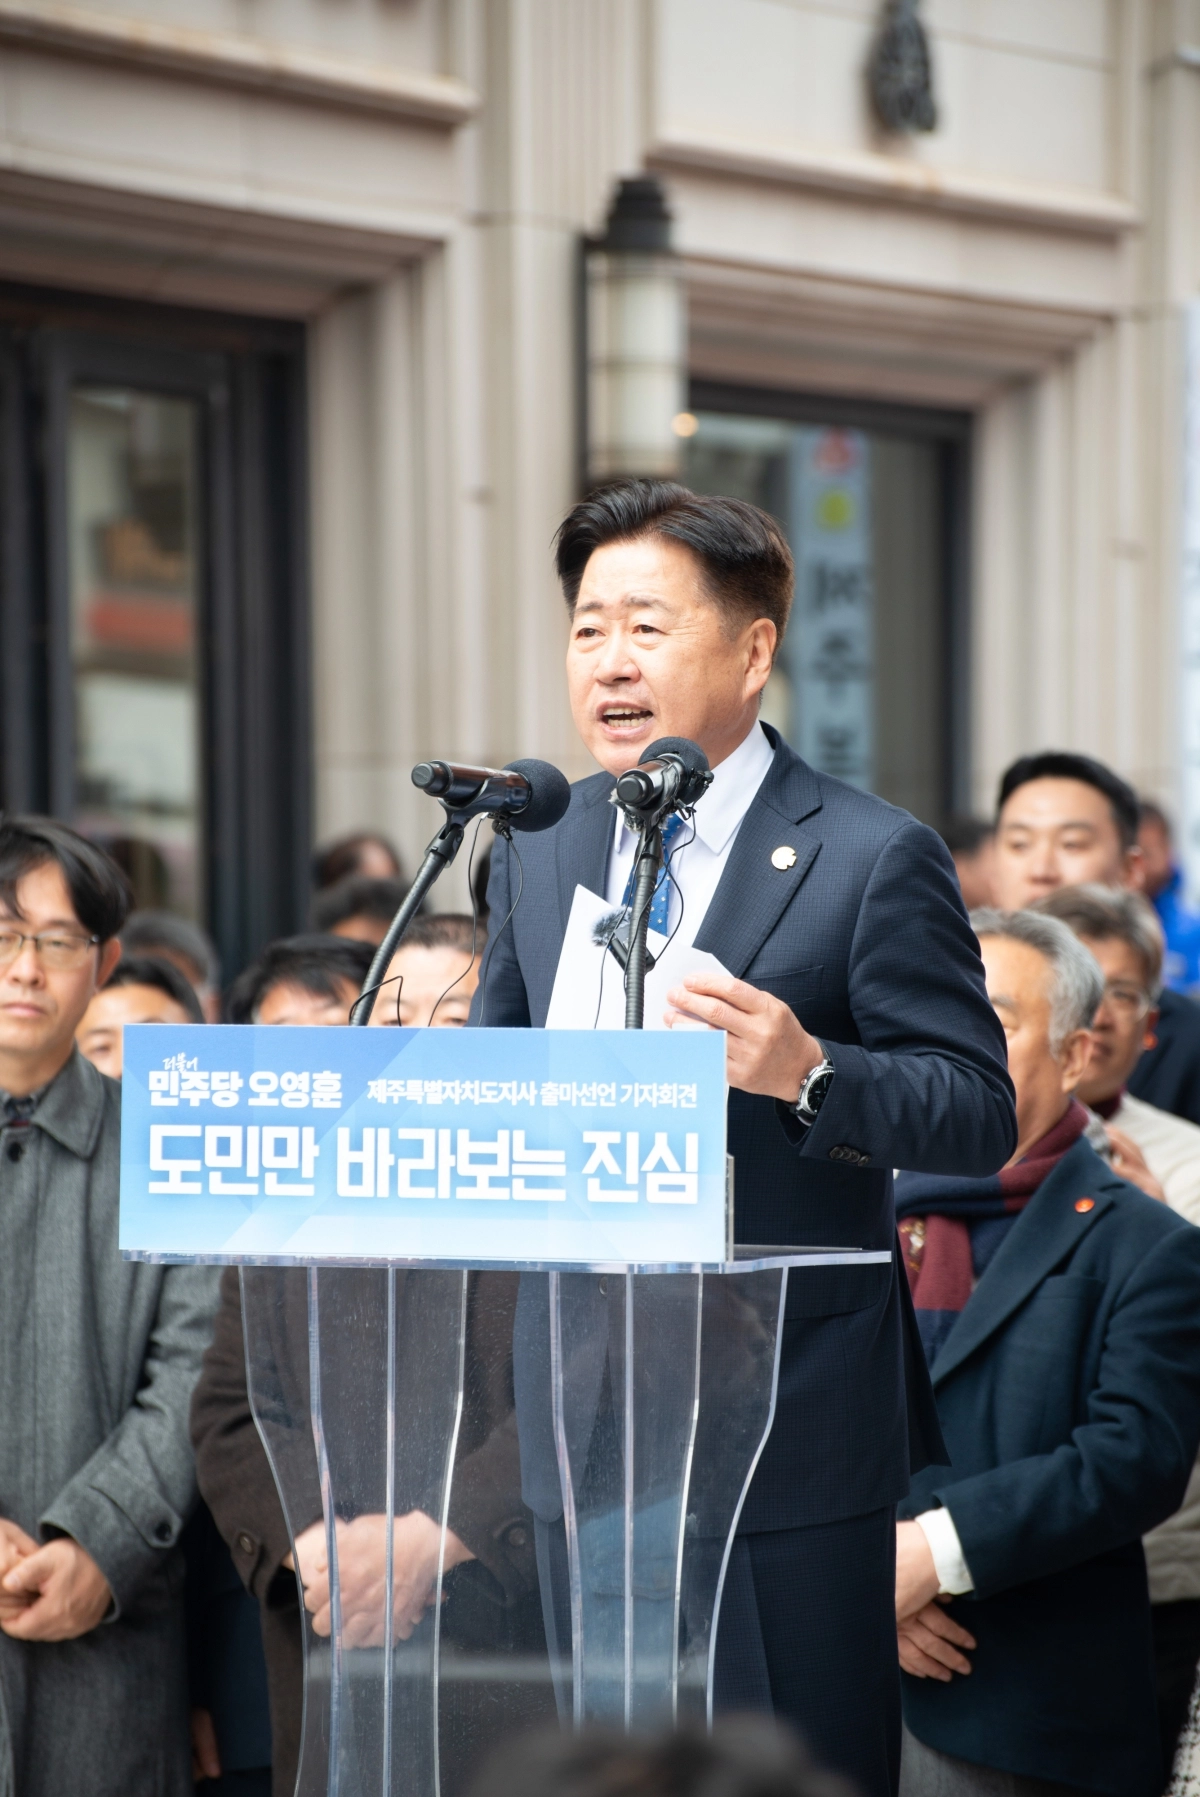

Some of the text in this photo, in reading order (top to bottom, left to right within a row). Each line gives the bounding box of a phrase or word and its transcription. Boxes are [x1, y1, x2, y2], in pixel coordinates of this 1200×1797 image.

[162, 1053, 198, 1073] 더불어
[149, 1070, 343, 1109] 민주당 오영훈
[367, 1079, 698, 1108] 제주특별자치도지사 출마선언 기자회견
[148, 1124, 699, 1205] 도민만 바라보는 진심
